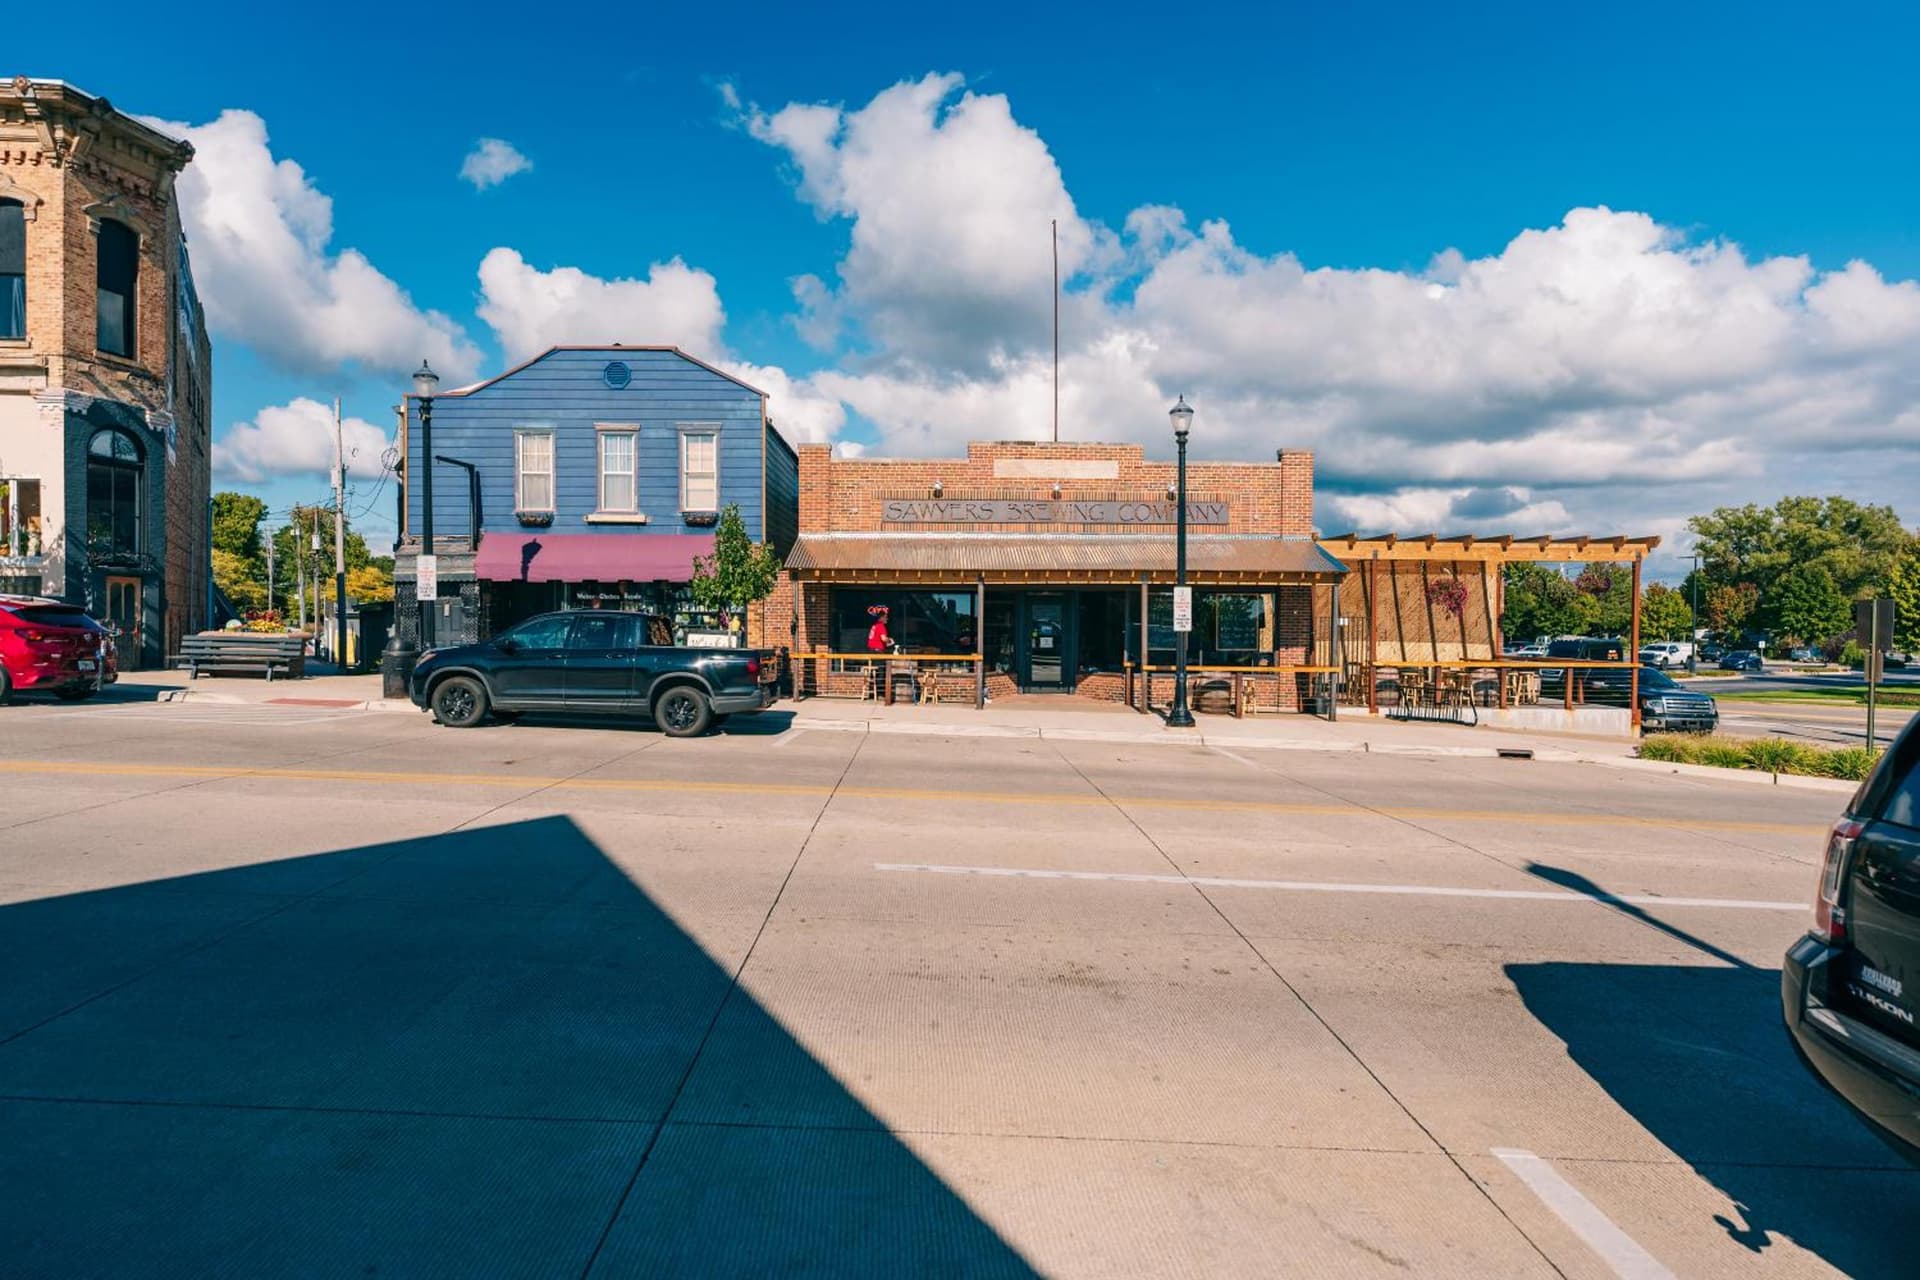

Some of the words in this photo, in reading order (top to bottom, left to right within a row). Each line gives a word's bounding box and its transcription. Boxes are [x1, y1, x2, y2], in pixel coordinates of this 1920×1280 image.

[886, 502, 994, 521] SAWYERS
[1007, 502, 1105, 521] BREWING
[1118, 503, 1224, 522] COMPANY
[1847, 983, 1914, 1024] YUKON
